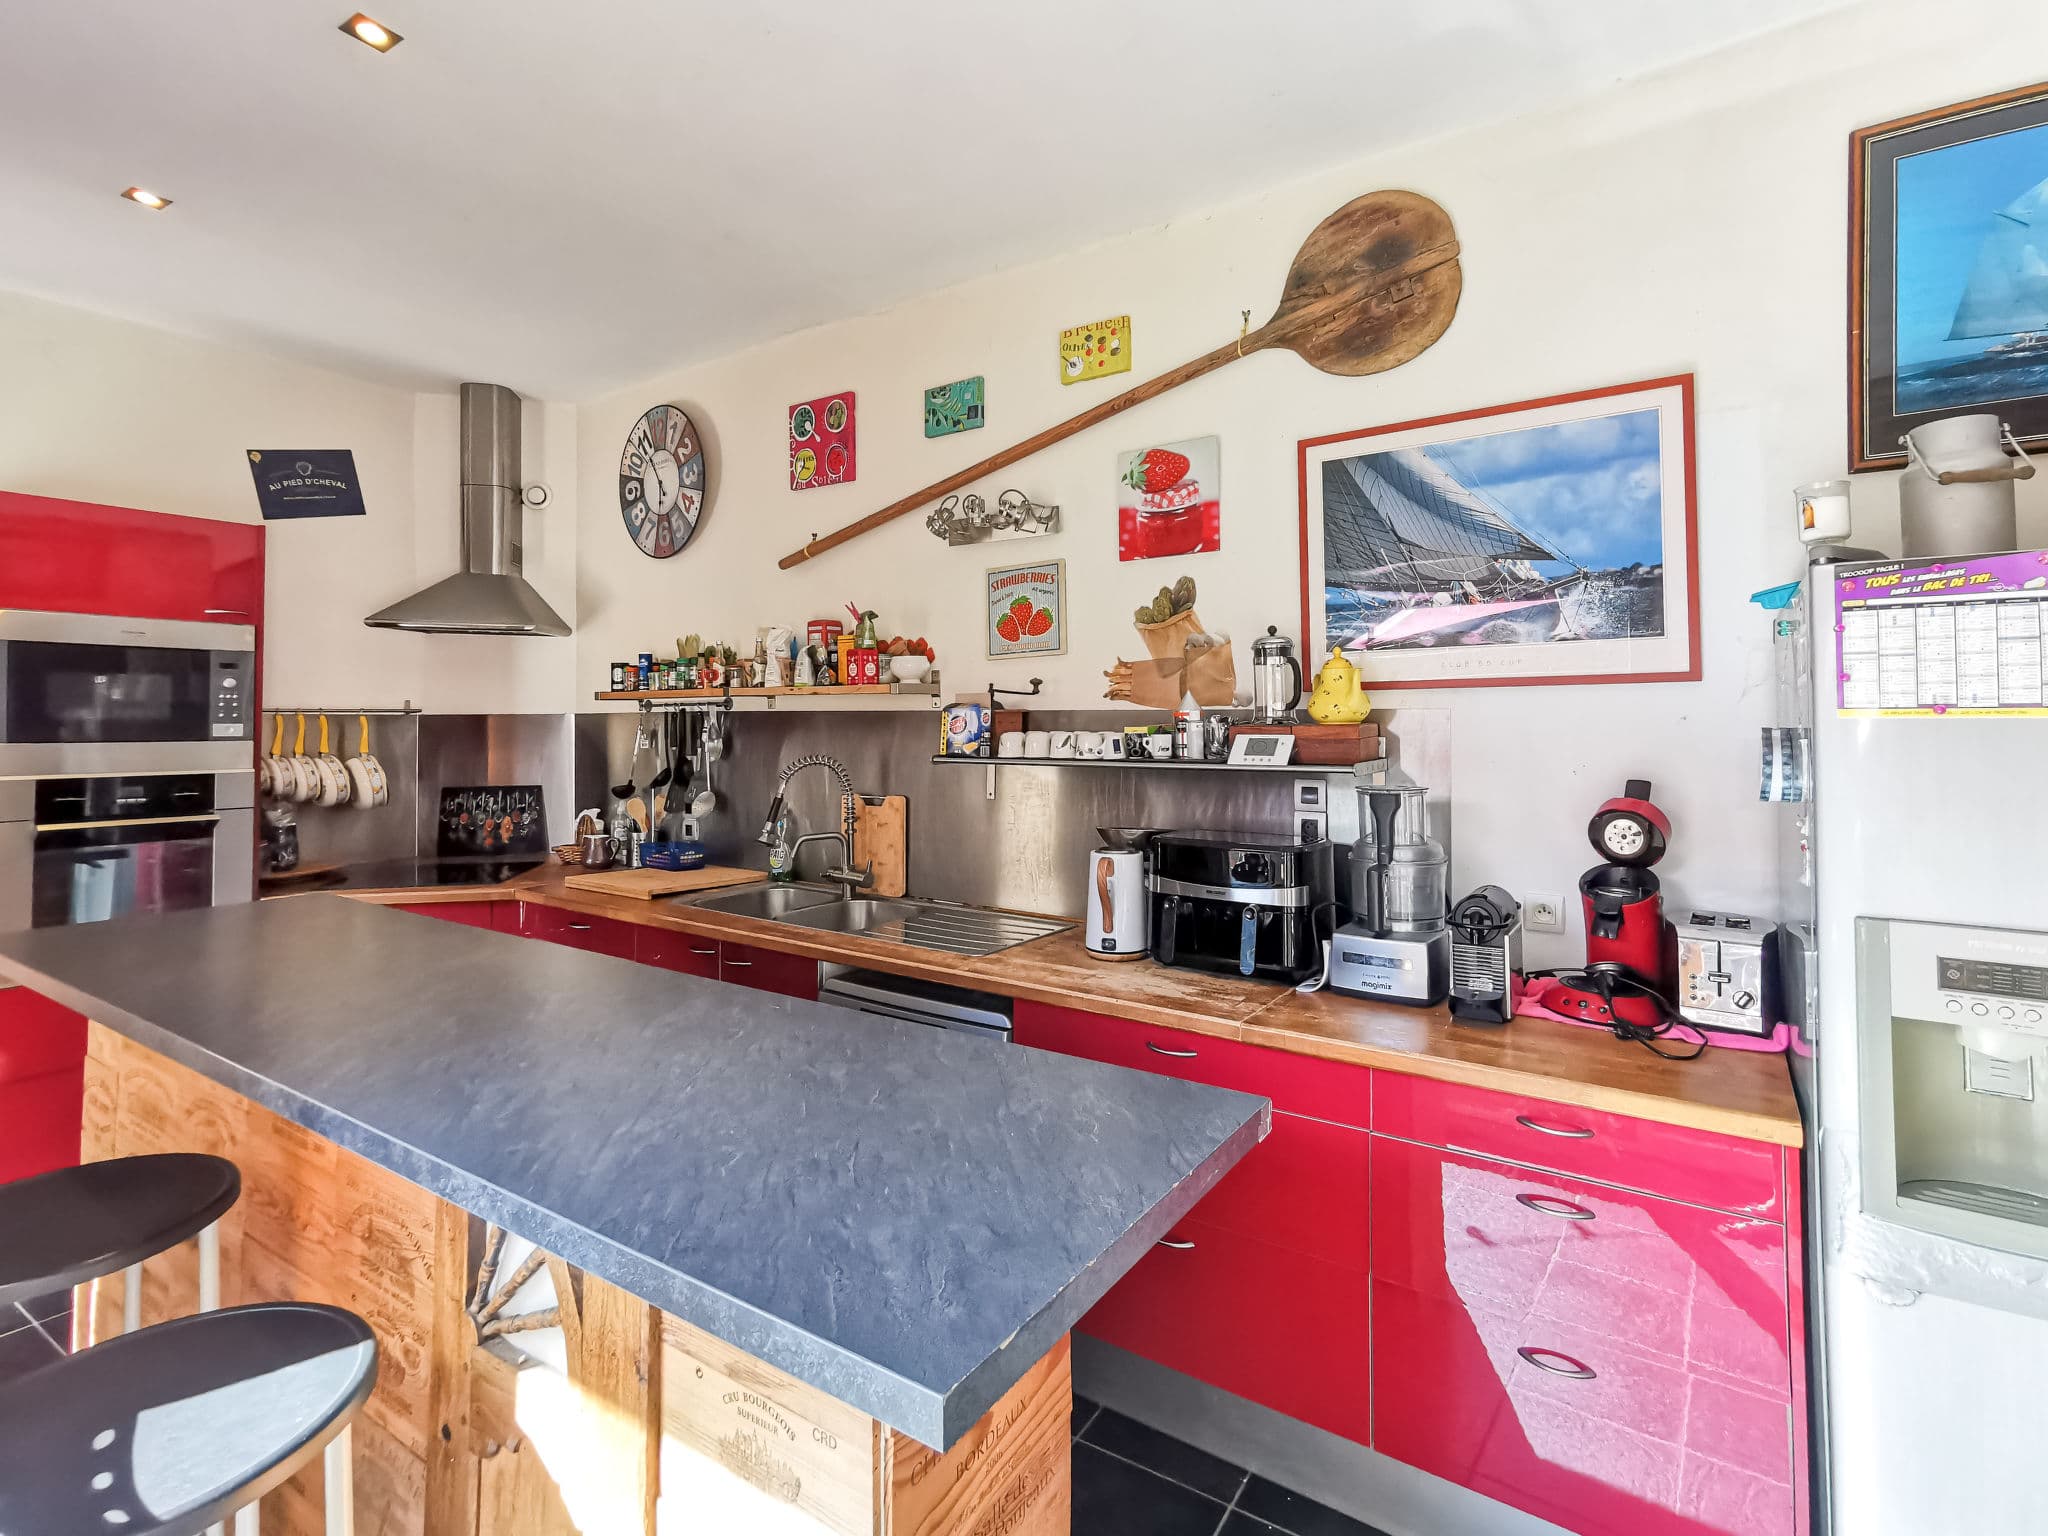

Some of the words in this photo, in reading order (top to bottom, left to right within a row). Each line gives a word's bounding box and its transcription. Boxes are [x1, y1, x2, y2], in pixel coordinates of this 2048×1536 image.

[638, 429, 653, 456] 11
[652, 419, 663, 443] 12
[669, 421, 678, 445] 1
[677, 437, 692, 462] 2
[628, 452, 644, 477] 10
[683, 463, 698, 485] 3
[268, 482, 282, 491] AU
[282, 479, 303, 487] PIED
[625, 480, 641, 501] 9
[631, 501, 646, 527] 8
[681, 491, 695, 514] 4
[645, 516, 656, 541] 7
[658, 521, 670, 547] 6
[671, 511, 684, 538] 5
[991, 572, 1056, 592] STRAWBERRIES
[1865, 573, 1901, 589] TOUS
[1902, 575, 1915, 583] LES
[1922, 580, 1947, 592] BAC
[1950, 577, 1965, 587] DE
[1361, 981, 1392, 990] magimix
[722, 1391, 740, 1404] CRU
[743, 1392, 796, 1441] BOURGEOIS
[737, 1406, 779, 1437] SUPERIEUR
[812, 1427, 838, 1449] CRD
[956, 1397, 1028, 1481] BORDEAUX
